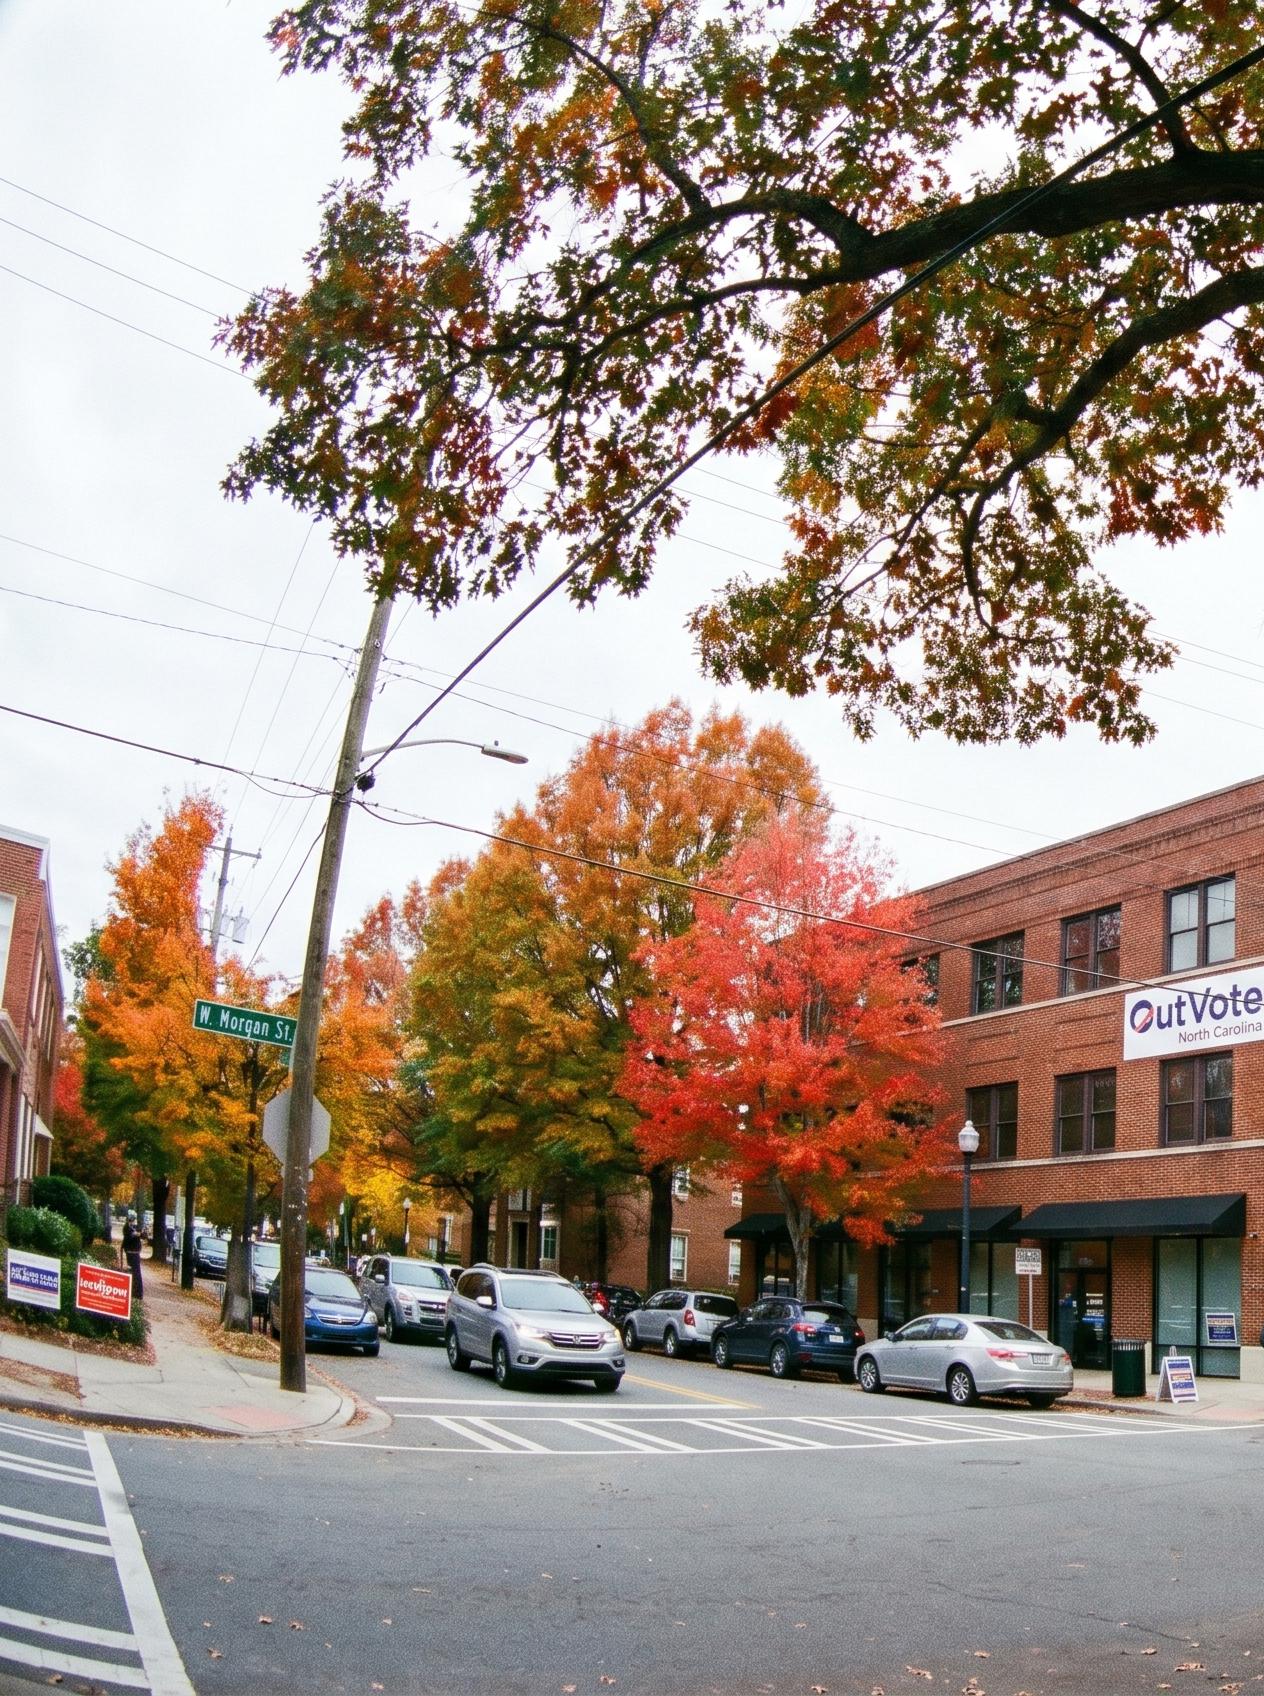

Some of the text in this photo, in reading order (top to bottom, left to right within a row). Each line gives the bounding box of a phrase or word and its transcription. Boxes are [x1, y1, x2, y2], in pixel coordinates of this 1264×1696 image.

[199, 1005, 293, 1042] W. Morgan St.
[1130, 984, 1263, 1034] OutVote
[1178, 1021, 1263, 1044] North Carolina
